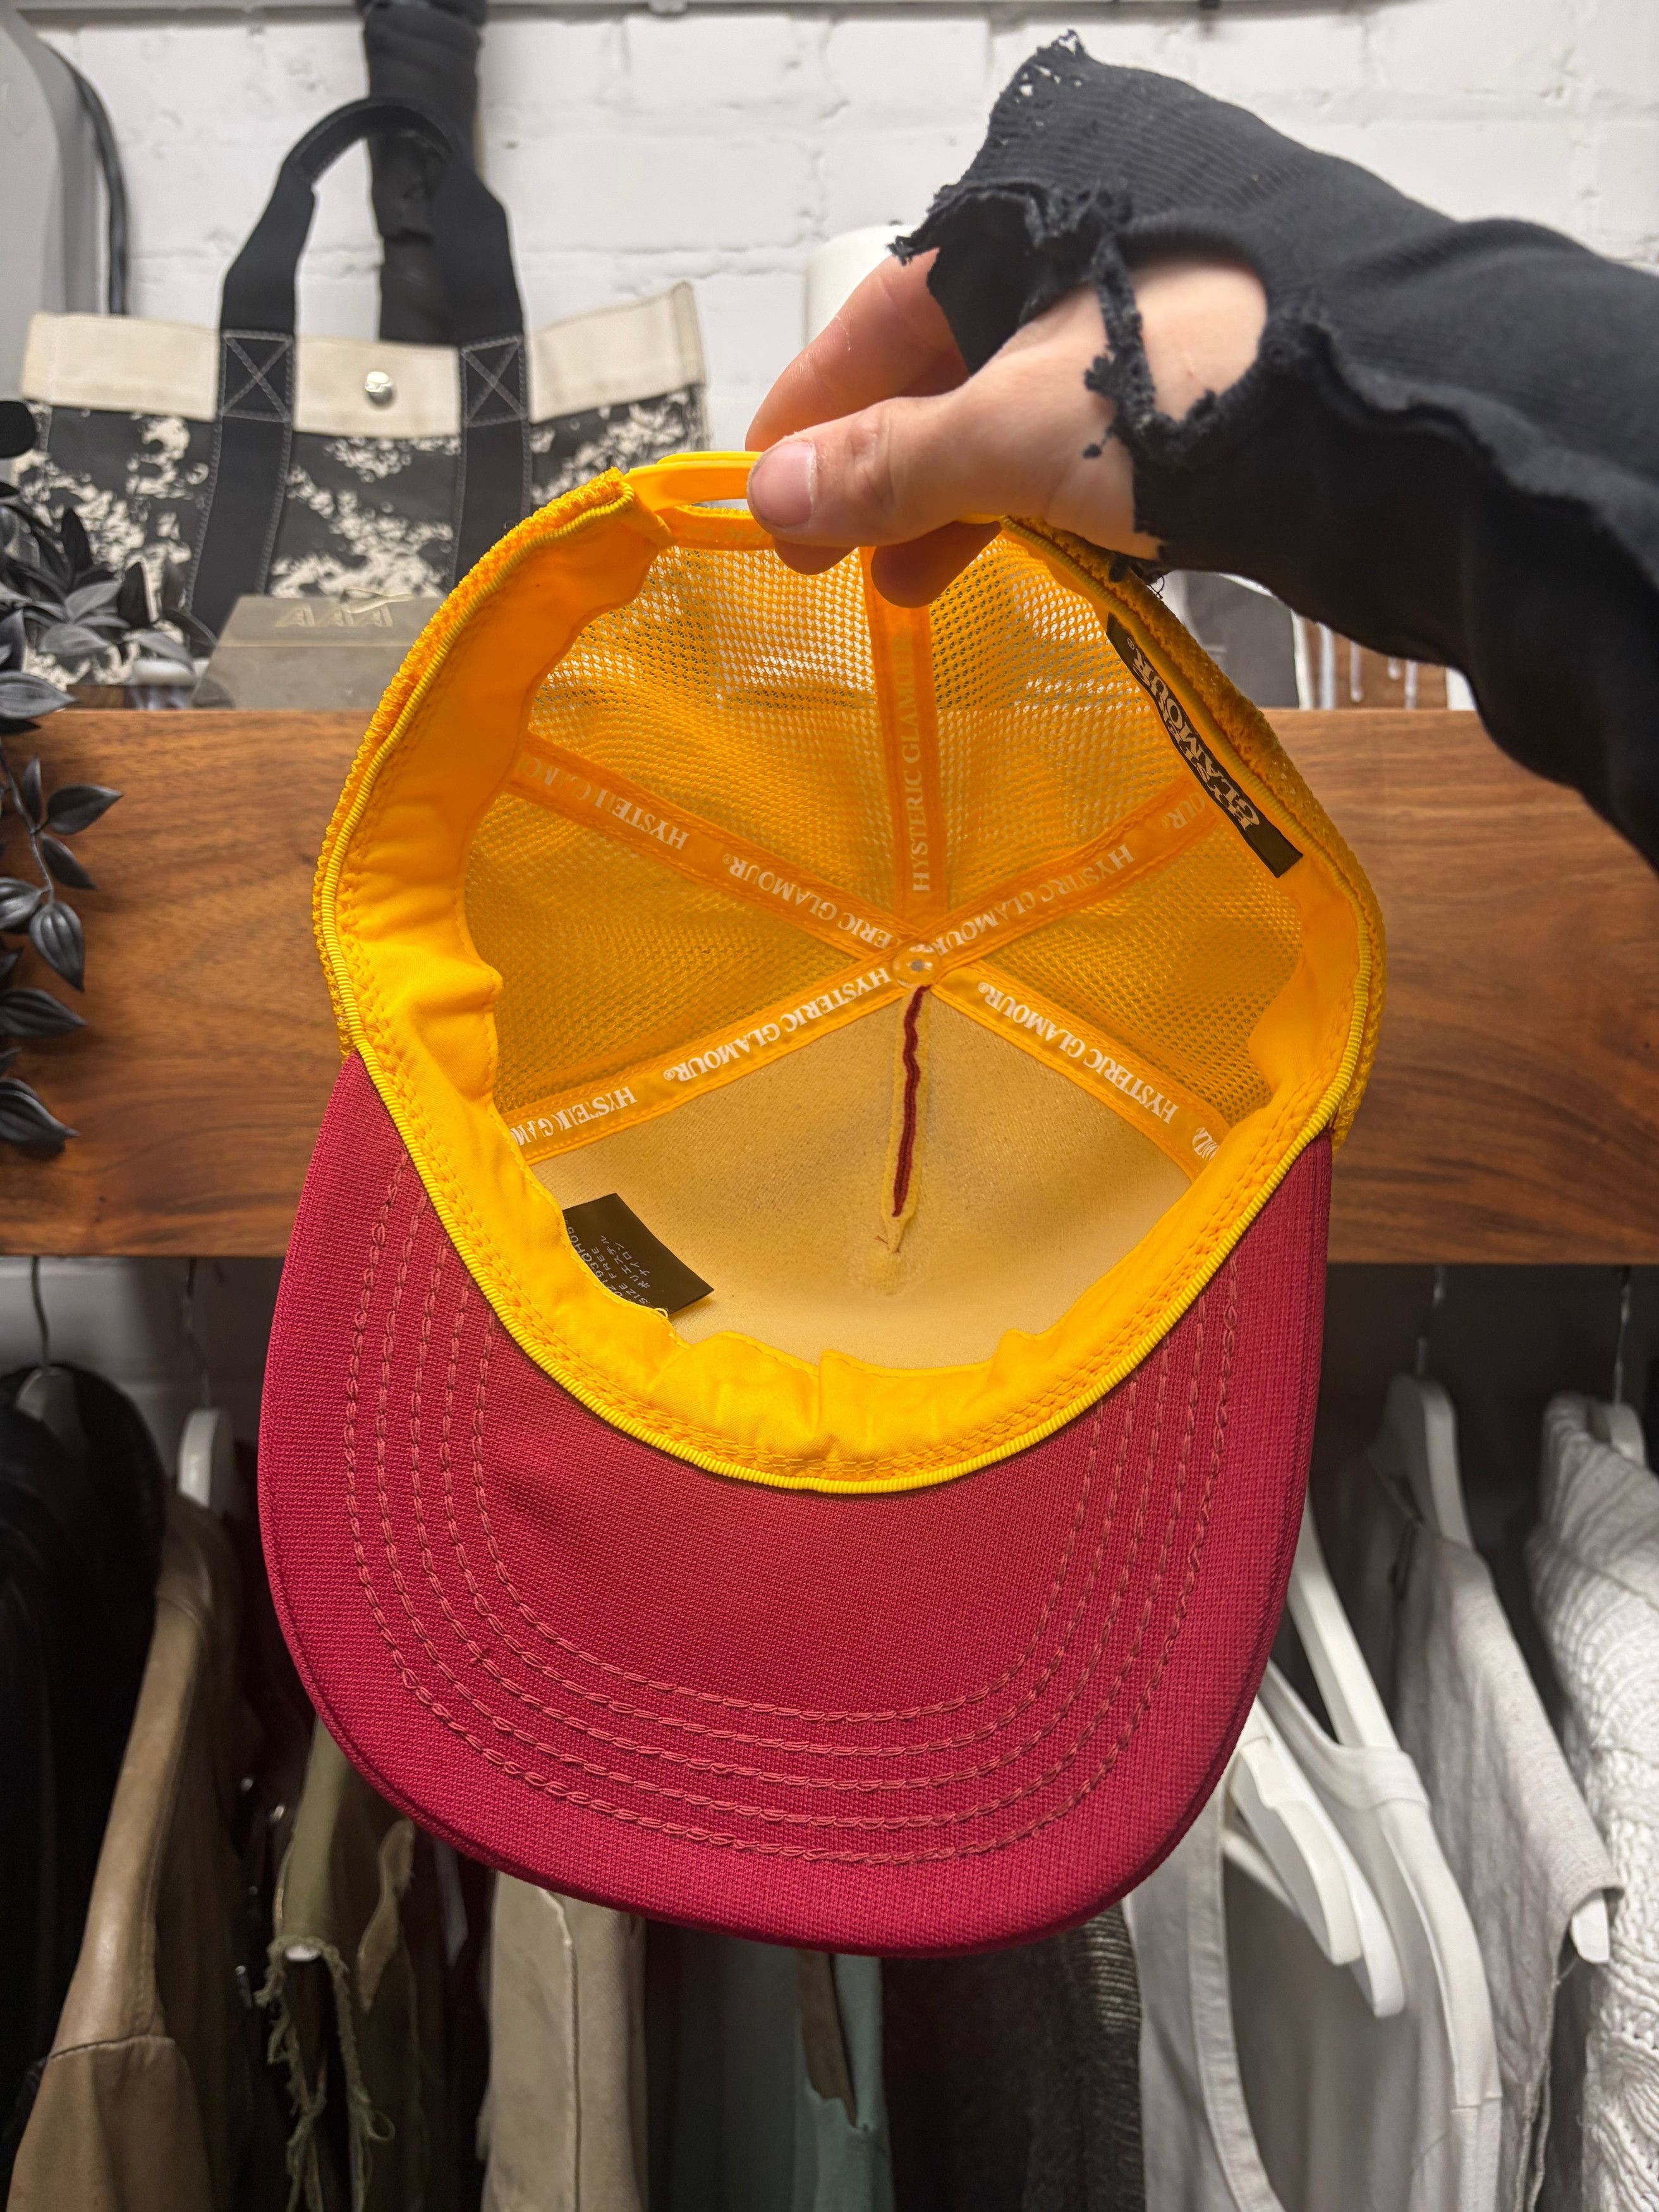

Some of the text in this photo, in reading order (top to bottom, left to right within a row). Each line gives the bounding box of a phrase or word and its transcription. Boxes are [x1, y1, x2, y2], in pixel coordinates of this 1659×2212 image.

[1133, 664, 1252, 831] HYSTERIC
[904, 772, 931, 892] HYSTERIC
[780, 966, 892, 1032] HYSTERIC
[1083, 1047, 1179, 1124] HYSTERIC
[591, 1247, 648, 1304] SIZE FREE
[615, 1242, 650, 1277] ナイロン
